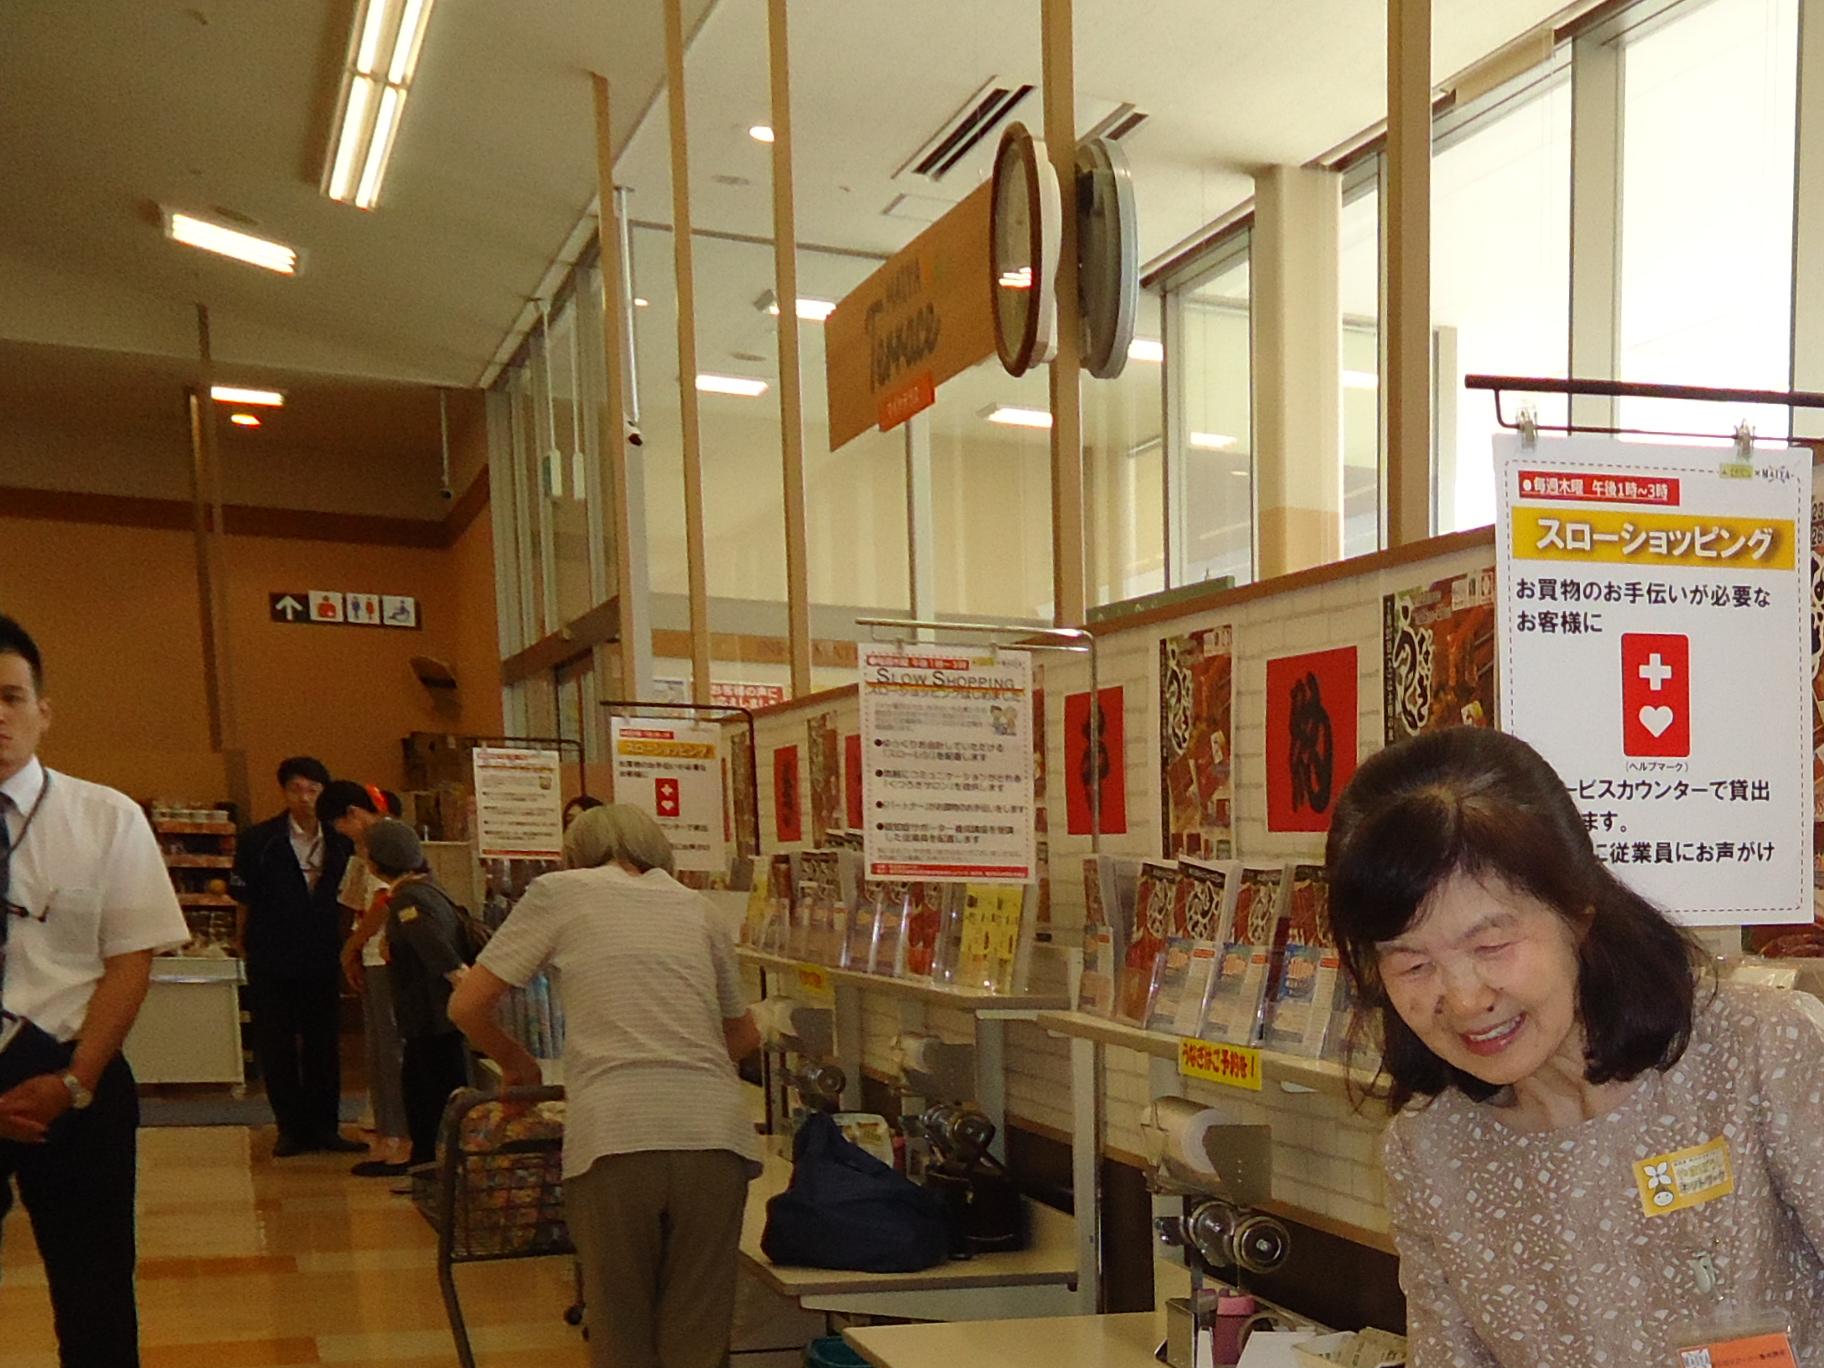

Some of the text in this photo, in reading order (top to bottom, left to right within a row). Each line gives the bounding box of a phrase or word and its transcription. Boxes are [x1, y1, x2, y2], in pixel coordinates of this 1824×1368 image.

[1535, 517, 1774, 561] スローショッピング
[1516, 577, 1772, 609] お買物のお手伝いが必要な
[1516, 611, 1604, 635] お客様に
